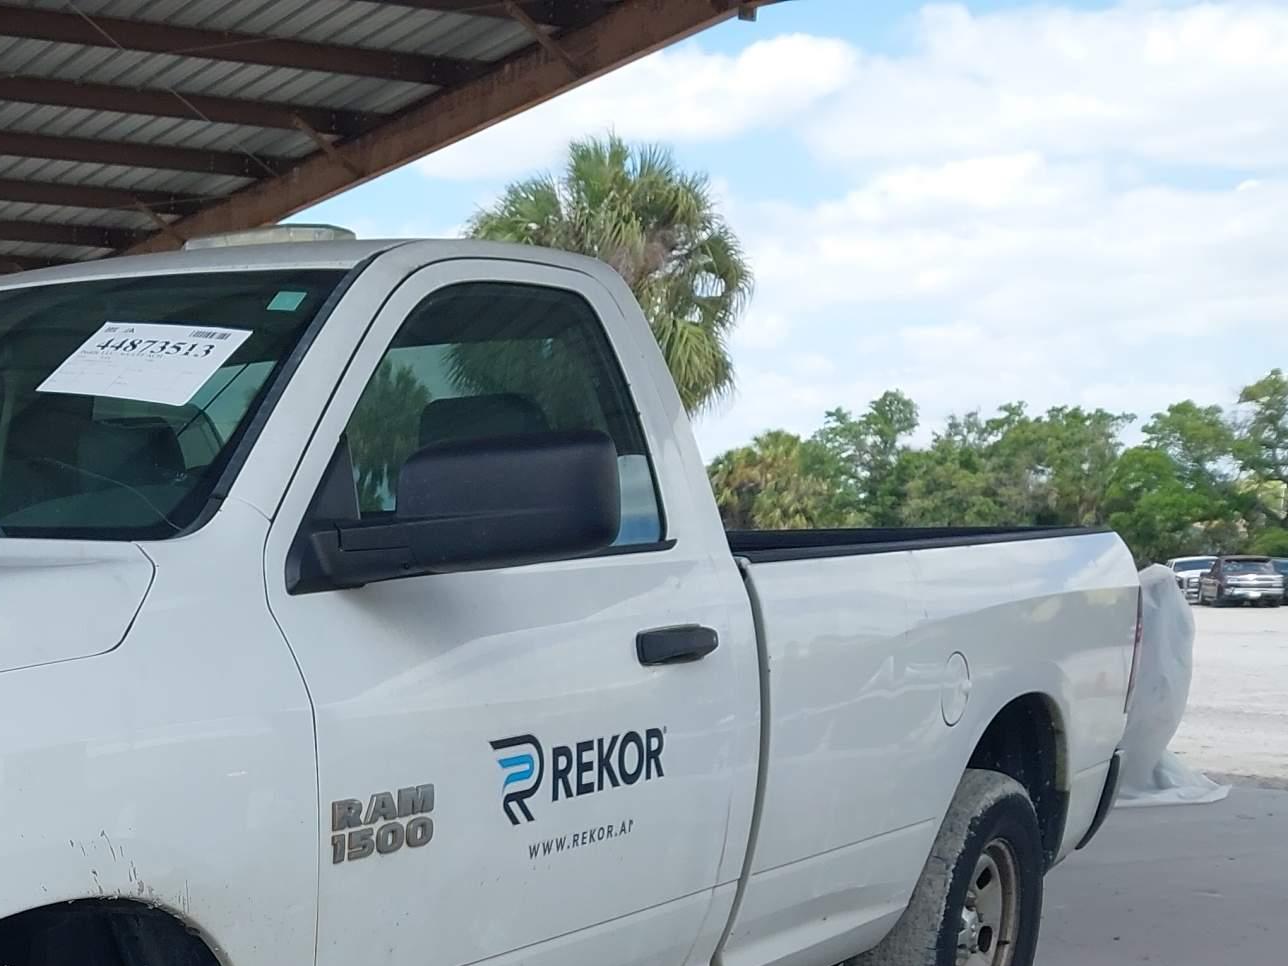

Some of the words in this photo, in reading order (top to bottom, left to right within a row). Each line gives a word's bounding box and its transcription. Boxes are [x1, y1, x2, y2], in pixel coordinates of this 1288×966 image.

[97, 337, 215, 358] 44873513
[551, 727, 664, 802] REKOR
[331, 783, 435, 832] RAM
[330, 816, 434, 864] 1500
